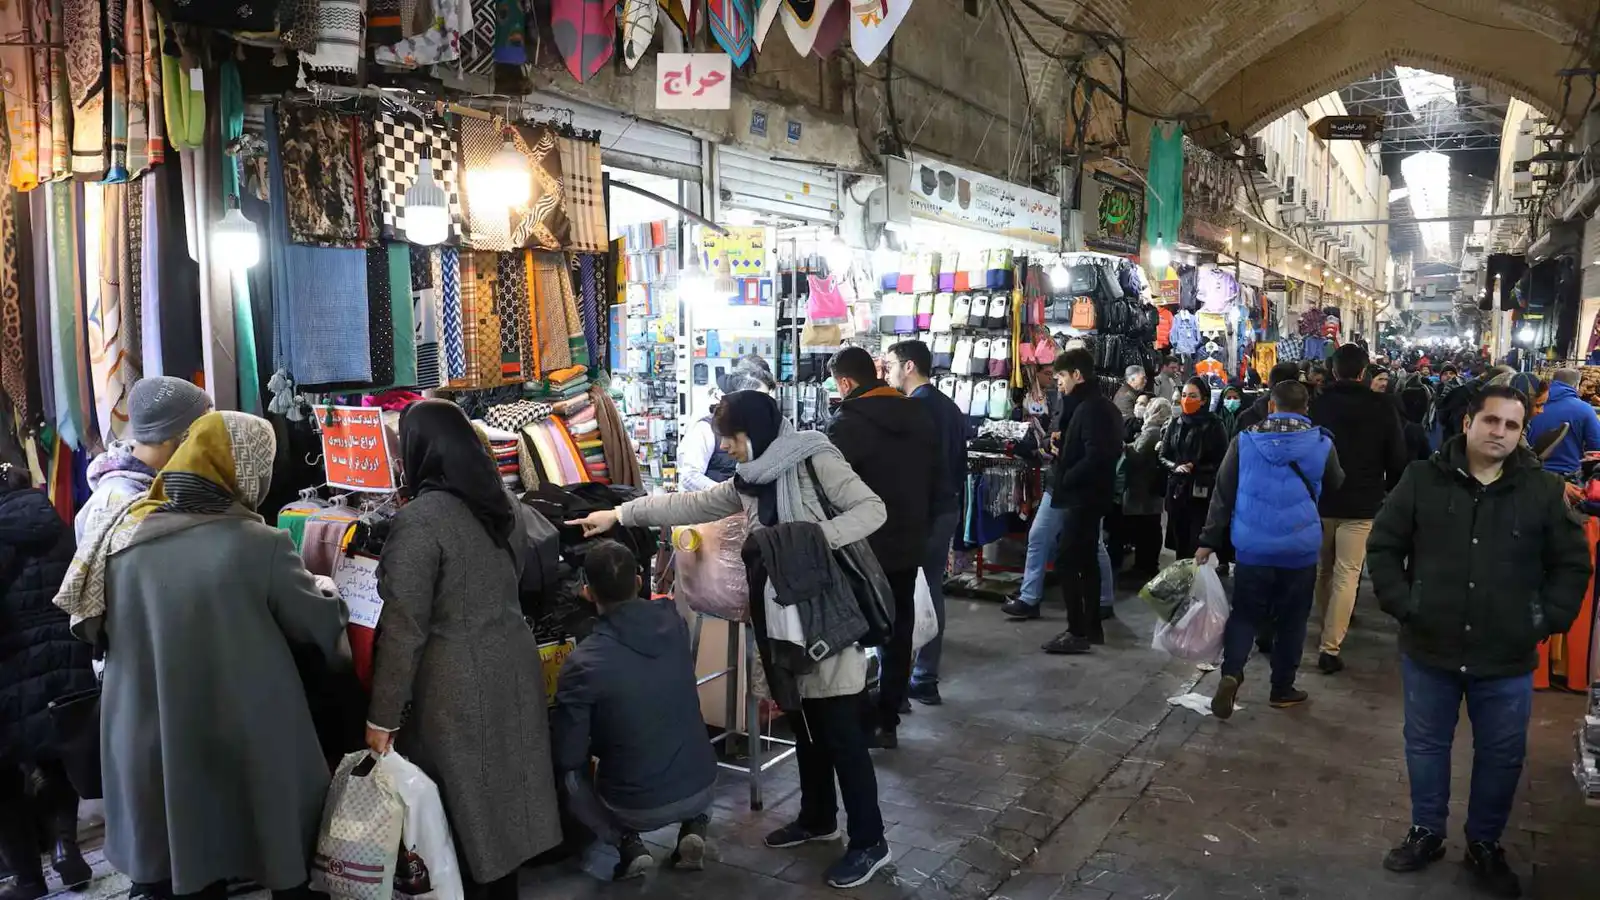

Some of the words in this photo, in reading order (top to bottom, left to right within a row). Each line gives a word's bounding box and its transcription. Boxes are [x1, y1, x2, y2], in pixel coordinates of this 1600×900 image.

[663, 62, 726, 96] حراج
[348, 435, 360, 448] شال
[360, 435, 377, 450] انواع
[360, 456, 379, 471] ارزان
